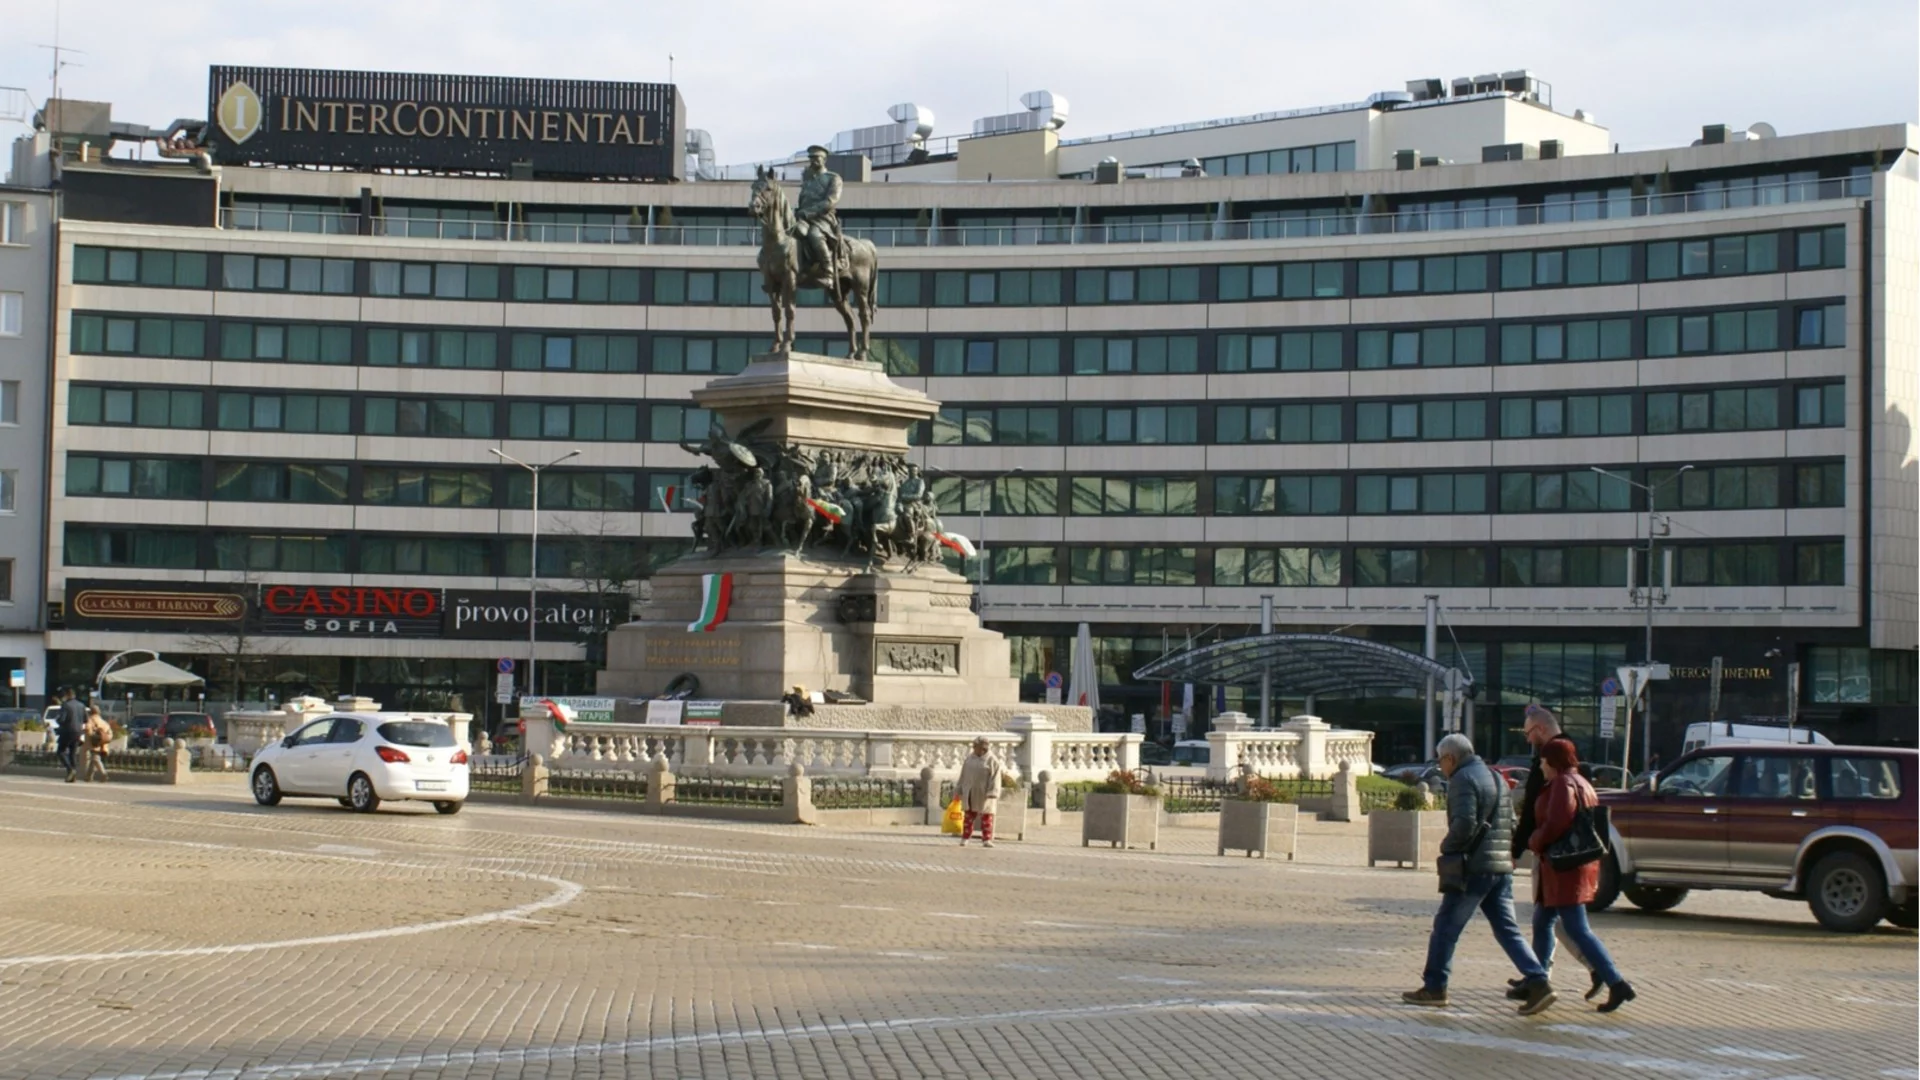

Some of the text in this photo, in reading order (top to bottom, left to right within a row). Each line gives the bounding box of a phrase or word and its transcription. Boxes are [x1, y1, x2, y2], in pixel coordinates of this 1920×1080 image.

[100, 598, 131, 610] CASA
[134, 601, 152, 610] DEL
[156, 600, 209, 612] HABANO
[265, 586, 437, 618] CASINO
[303, 618, 398, 634] SOFIA
